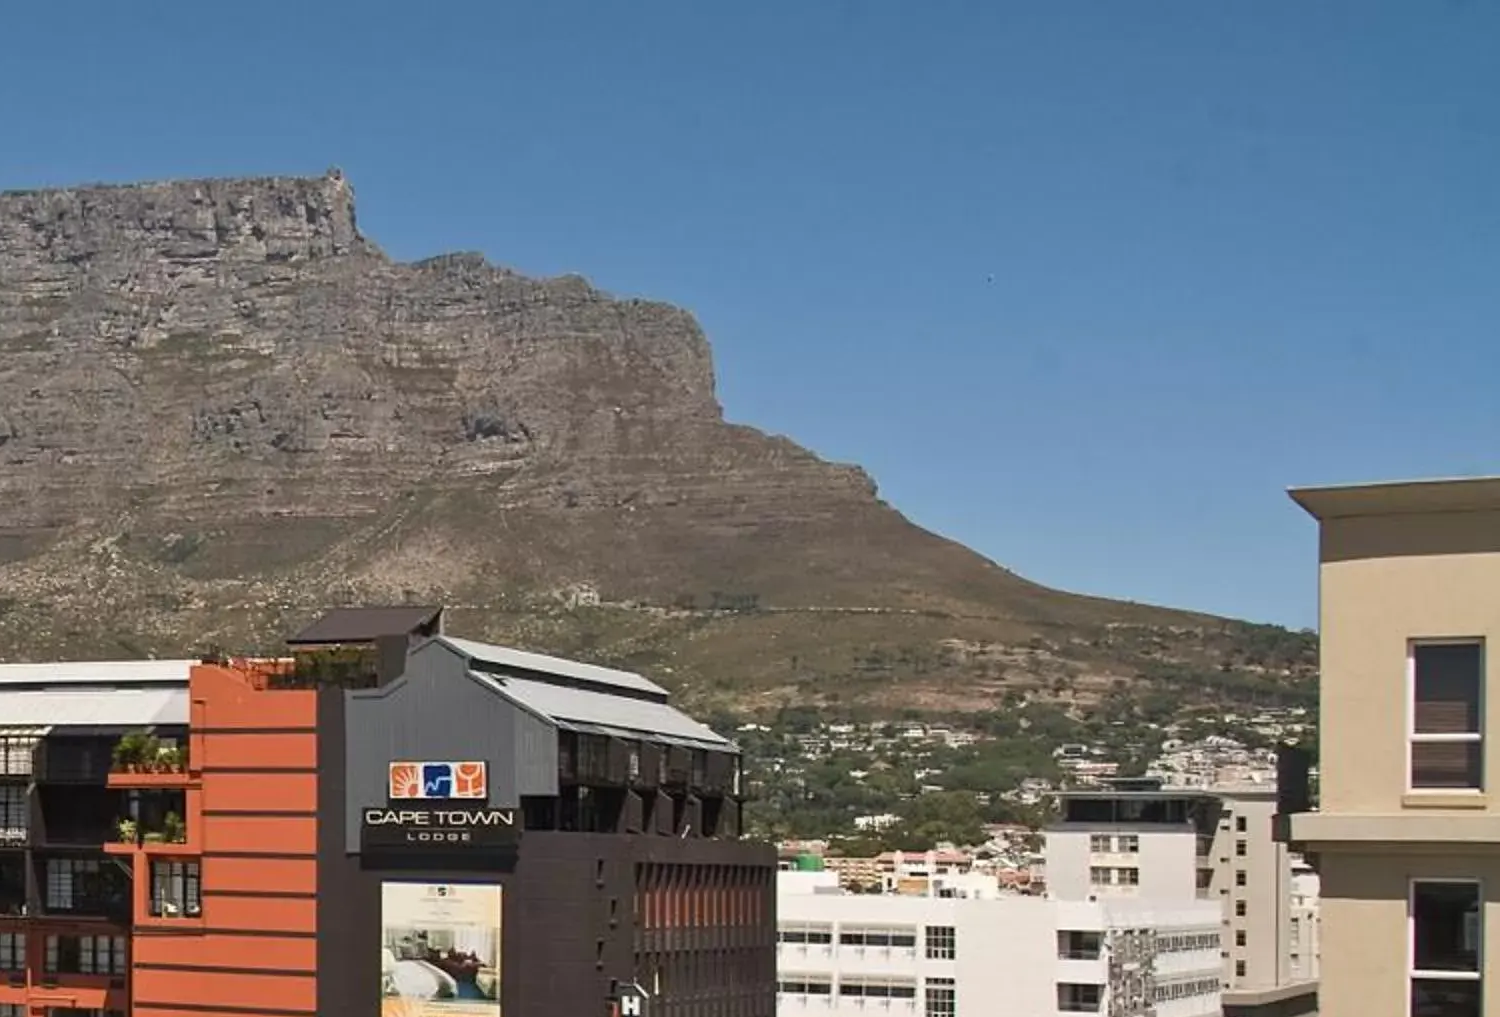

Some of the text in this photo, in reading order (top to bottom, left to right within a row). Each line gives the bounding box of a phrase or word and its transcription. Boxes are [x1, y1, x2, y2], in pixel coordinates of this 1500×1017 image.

[366, 811, 513, 825] CAPE TOWN
[407, 832, 471, 841] LODGE
